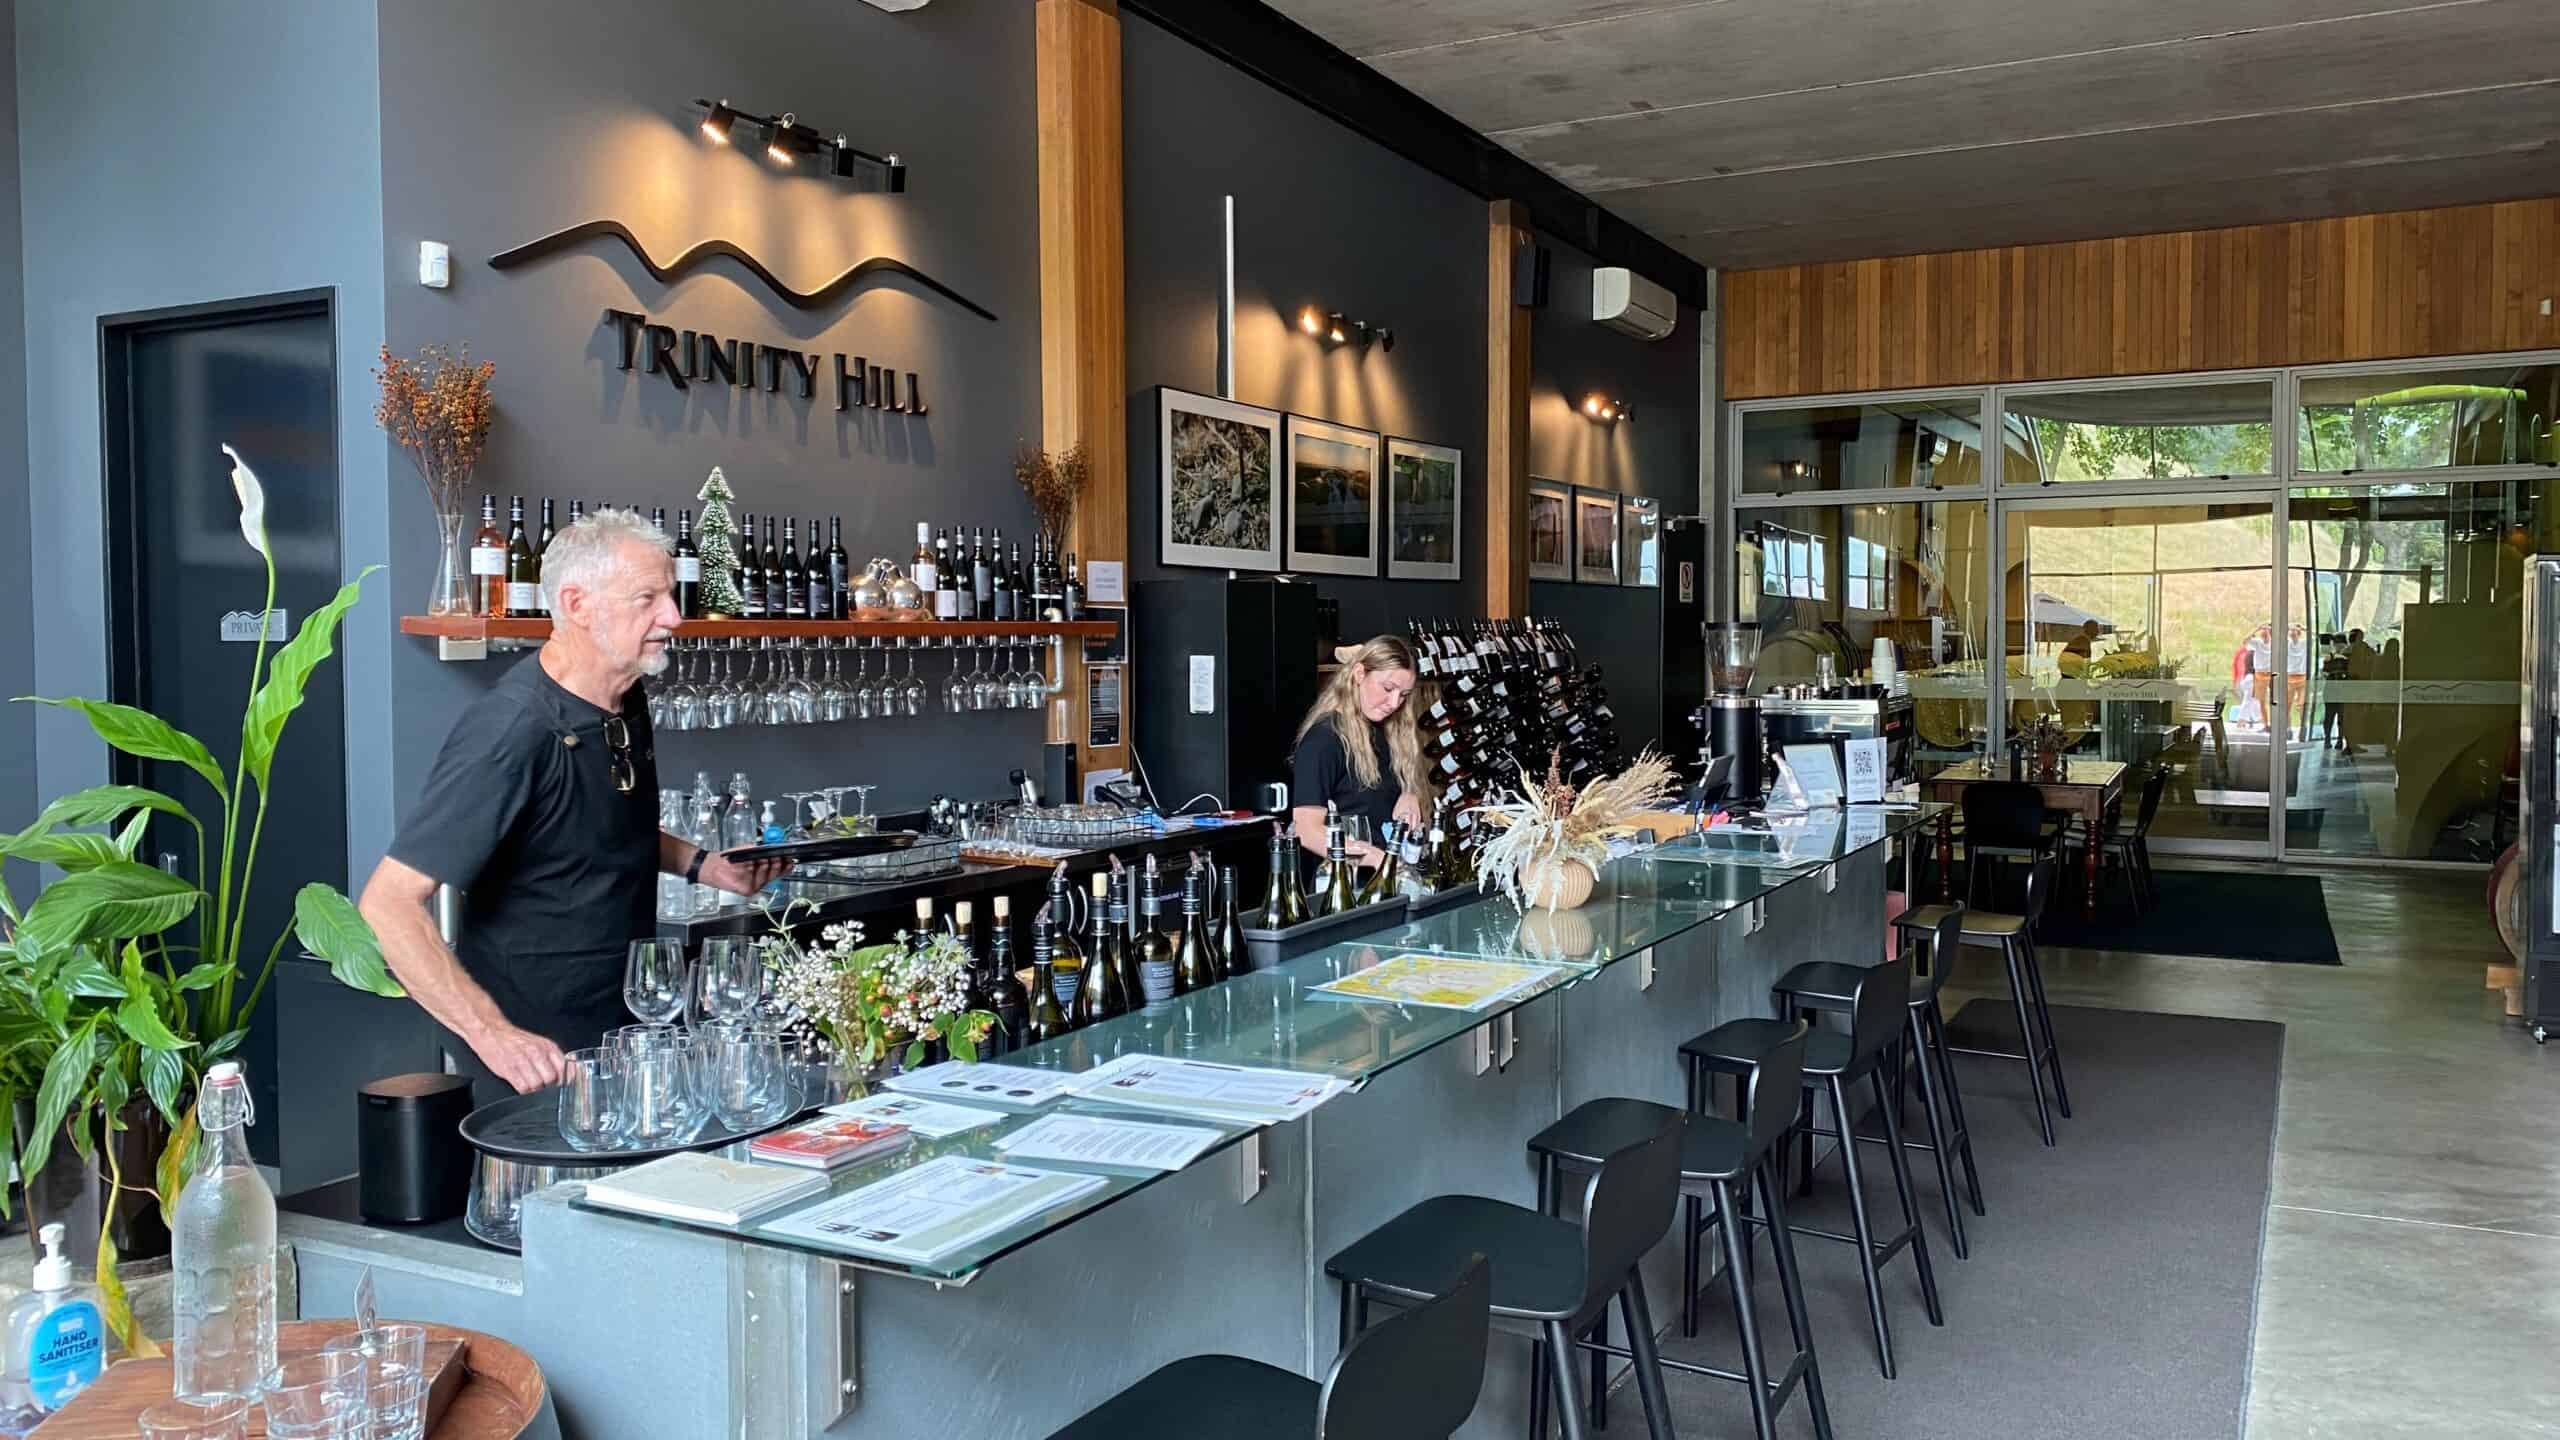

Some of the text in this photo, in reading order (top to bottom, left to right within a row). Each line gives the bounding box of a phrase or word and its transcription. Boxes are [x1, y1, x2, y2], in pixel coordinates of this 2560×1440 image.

[604, 308, 929, 417] TRINITY HILL
[231, 622, 273, 633] PRIVAE
[39, 1337, 99, 1364] SANITISER
[53, 1331, 88, 1348] HAND
